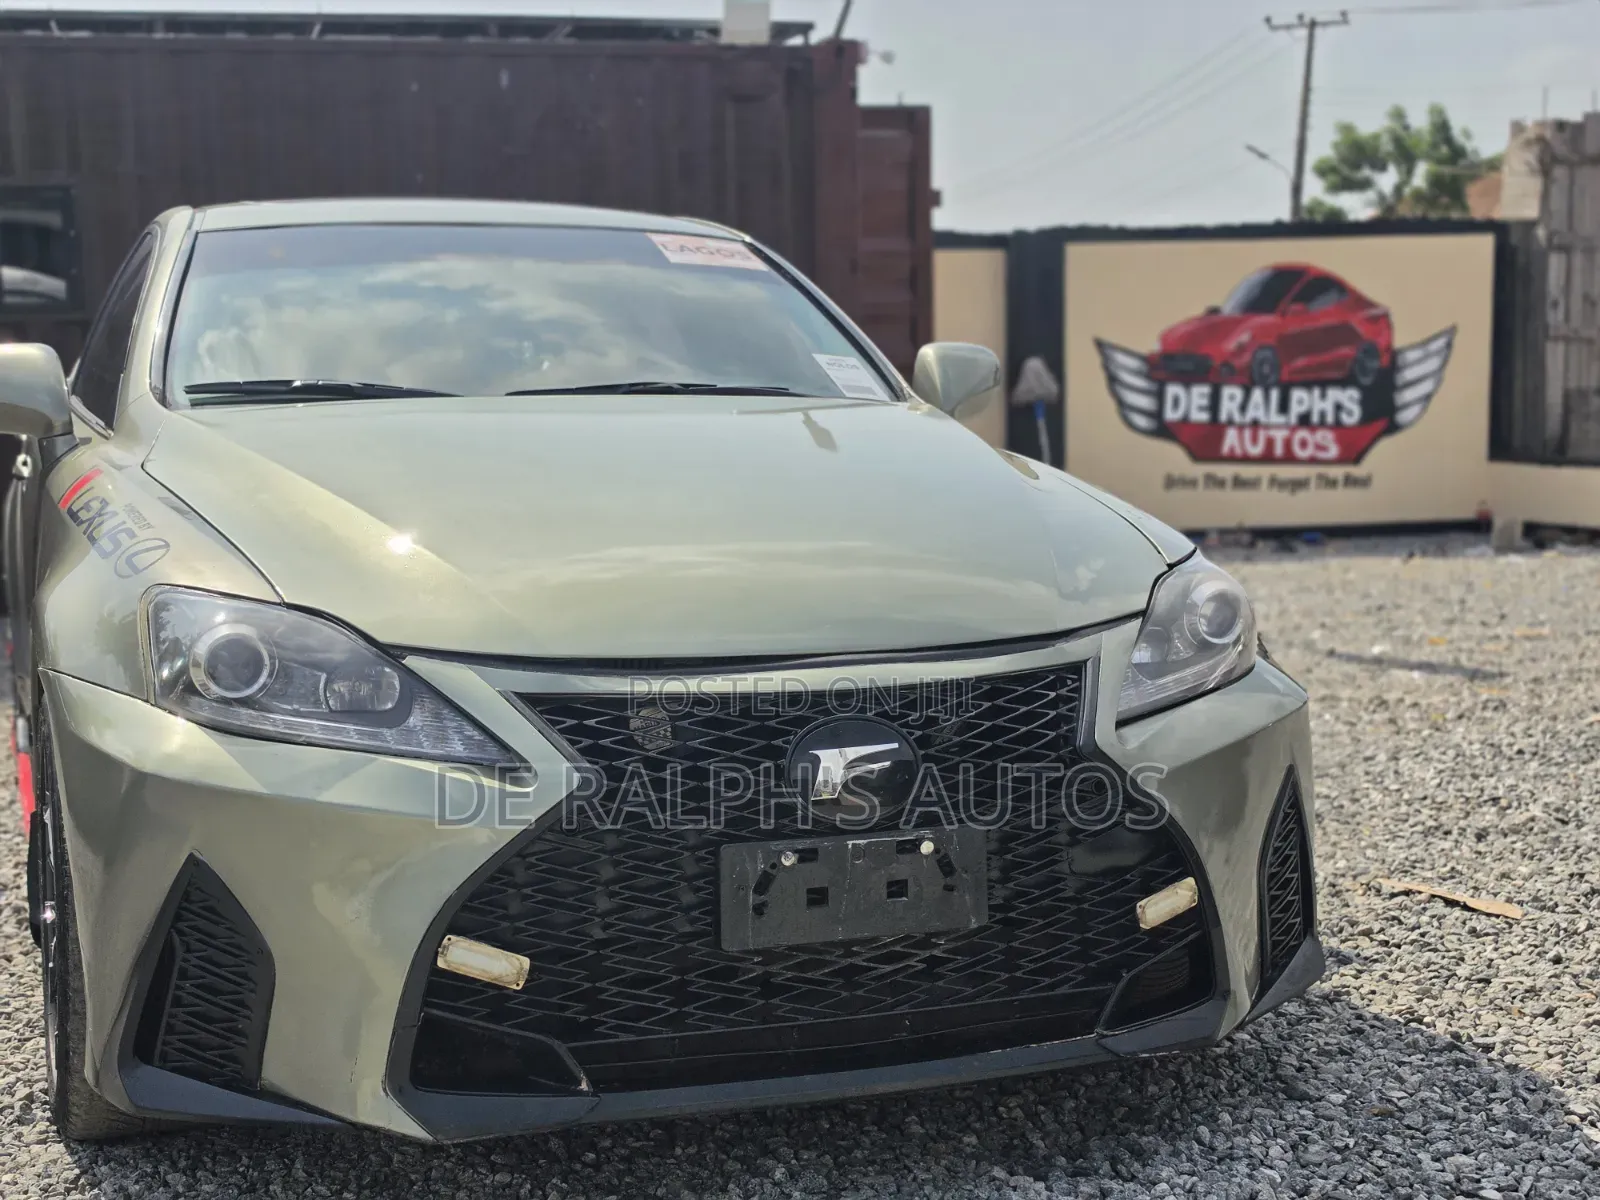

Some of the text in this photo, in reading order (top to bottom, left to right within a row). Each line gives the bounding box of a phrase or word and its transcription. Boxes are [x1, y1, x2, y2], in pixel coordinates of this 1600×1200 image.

[660, 243, 754, 260] LAGOS
[1163, 383, 1362, 426] DE RALPH'S
[1221, 426, 1341, 460] AUTOS
[1163, 472, 1198, 493] Drive
[1203, 472, 1228, 490] The
[1231, 472, 1262, 490] Best
[1314, 472, 1339, 490] The
[66, 486, 138, 560] LEXUS
